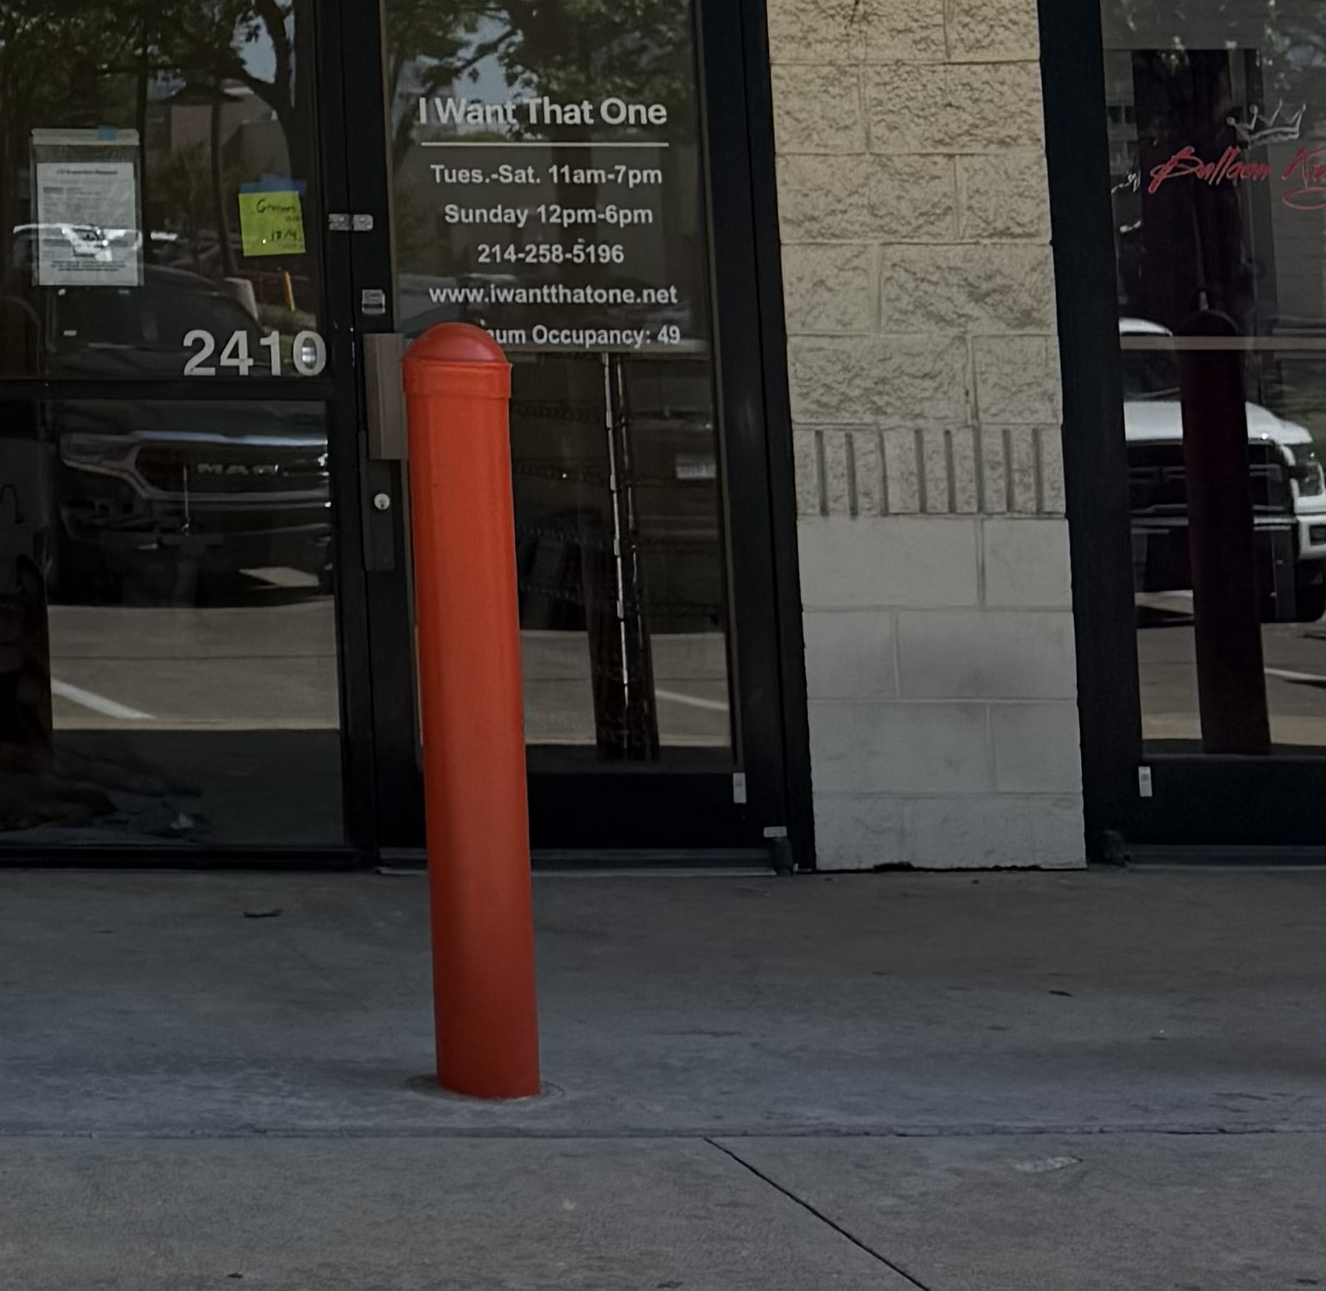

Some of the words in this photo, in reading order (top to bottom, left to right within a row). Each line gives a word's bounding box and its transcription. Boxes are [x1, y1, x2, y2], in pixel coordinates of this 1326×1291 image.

[418, 97, 427, 125] I
[435, 97, 517, 125] Want
[522, 96, 595, 125] That
[600, 98, 668, 126] One
[430, 164, 541, 185] Tues.-Sat.
[548, 164, 663, 188] 11am-7pm
[444, 203, 529, 228] Sunday
[536, 203, 654, 228] 12pm-6pm
[477, 243, 625, 264] 214-258-5196
[428, 284, 678, 304] www.iwantthatone.net
[532, 324, 652, 348] Occupancy:
[657, 324, 681, 345] 49
[182, 328, 327, 377] 2410
